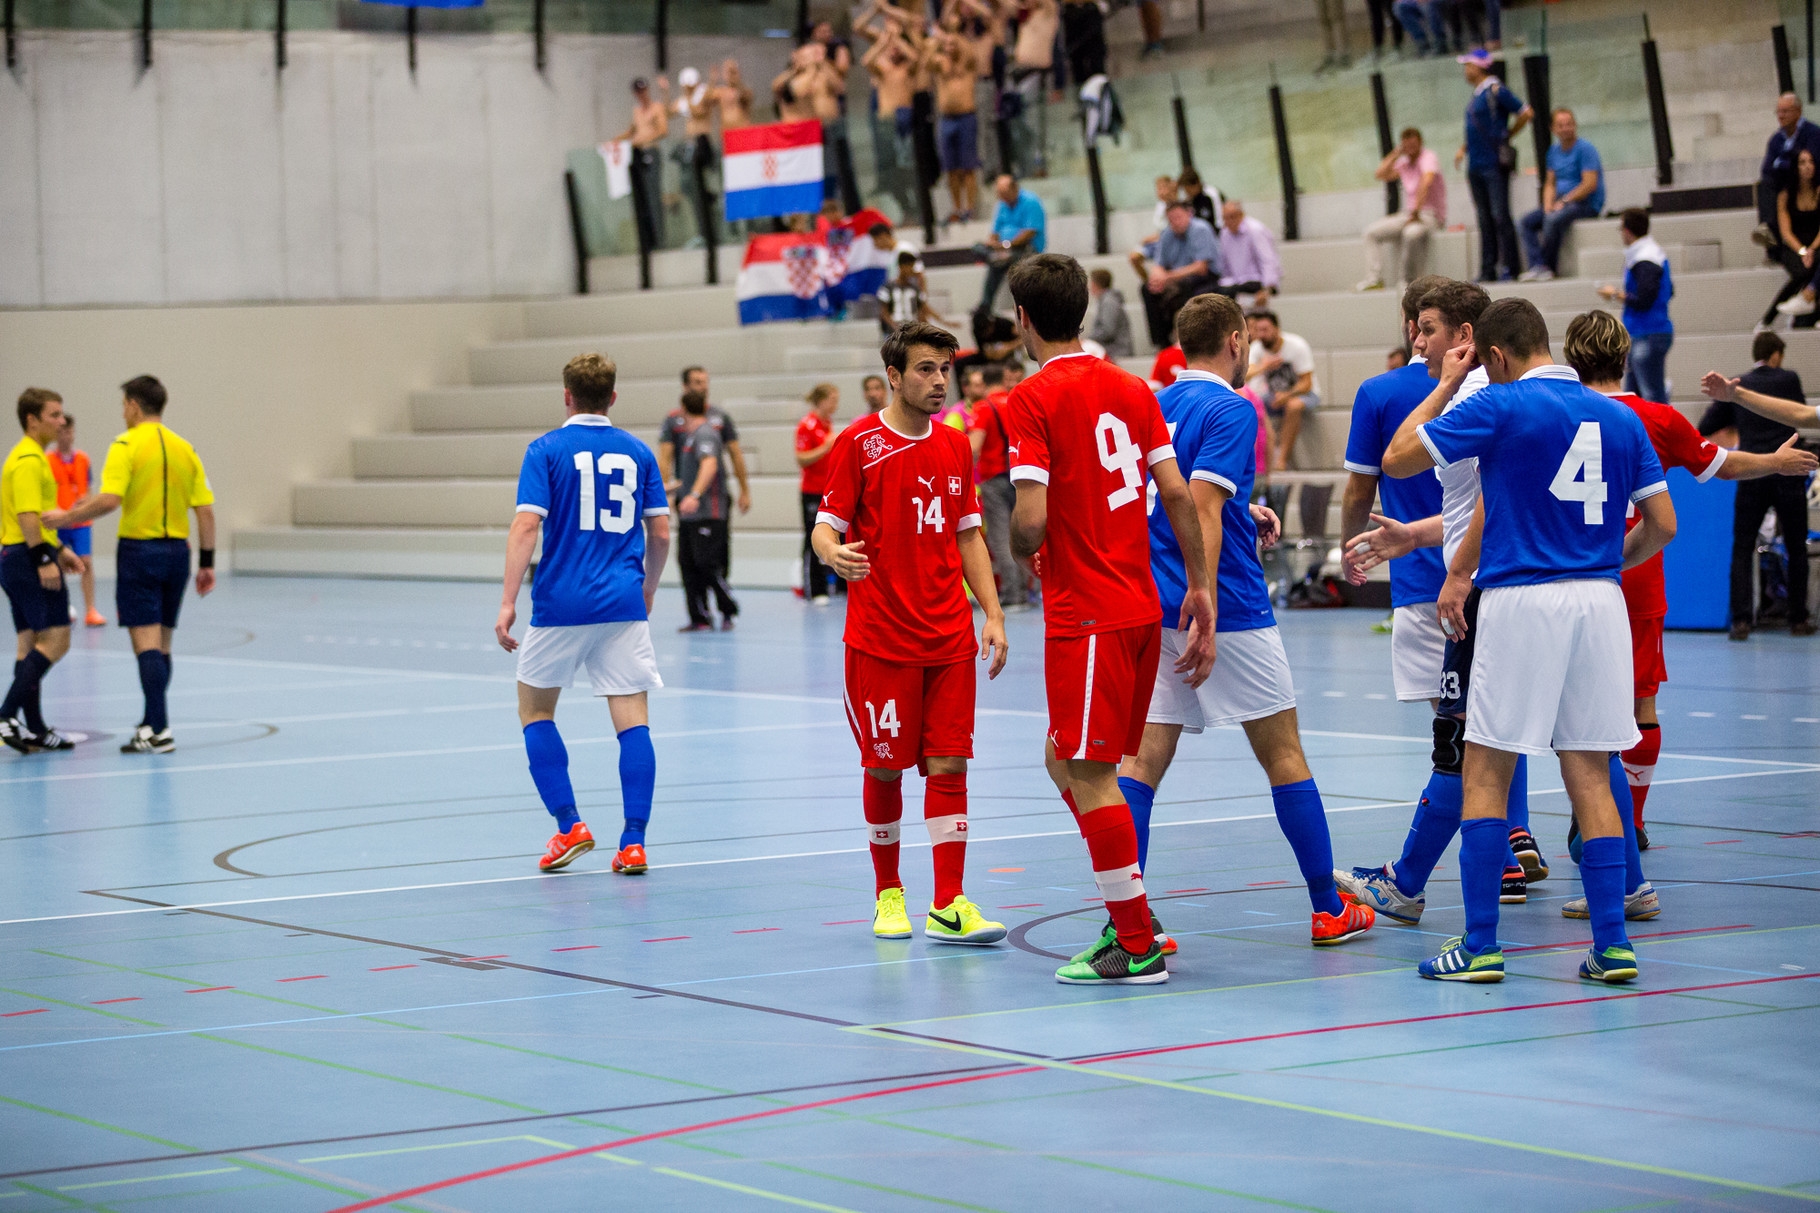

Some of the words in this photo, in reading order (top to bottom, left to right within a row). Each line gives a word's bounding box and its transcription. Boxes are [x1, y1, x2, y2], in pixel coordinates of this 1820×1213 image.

[573, 451, 638, 535] 13
[1095, 412, 1143, 512] 9
[1548, 421, 1608, 525] 4
[911, 496, 946, 534] 14
[865, 699, 901, 738] 14
